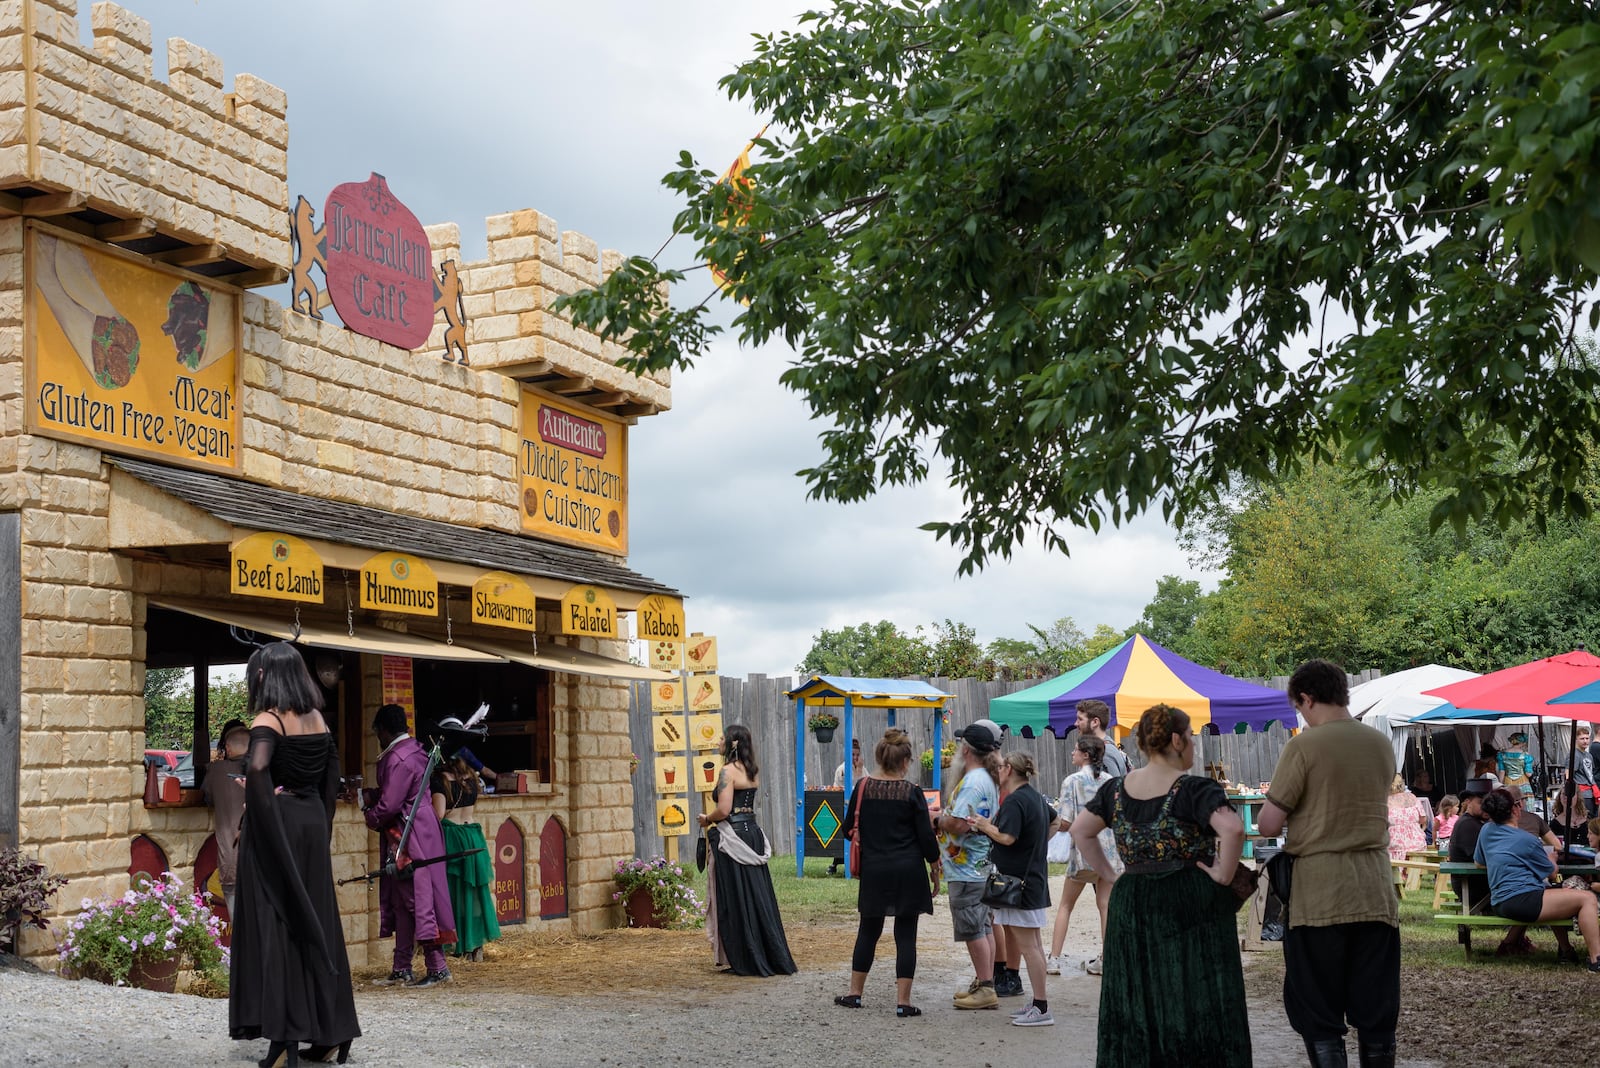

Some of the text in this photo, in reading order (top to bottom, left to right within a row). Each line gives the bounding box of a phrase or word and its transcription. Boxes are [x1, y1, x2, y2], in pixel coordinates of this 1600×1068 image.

[330, 202, 427, 281] Jerusalem
[40, 382, 115, 434] Gluten
[543, 408, 603, 453] Authentic
[521, 439, 621, 502] Middle Eastern
[543, 489, 601, 534] Cuisine
[236, 559, 321, 596] Beef & Lamb
[364, 570, 435, 610] Hummus
[475, 591, 534, 626] Shawarma
[570, 604, 612, 634] Falafel
[643, 610, 680, 638] Kabob
[497, 895, 520, 915] Lamb
[540, 880, 565, 901] Kabob
